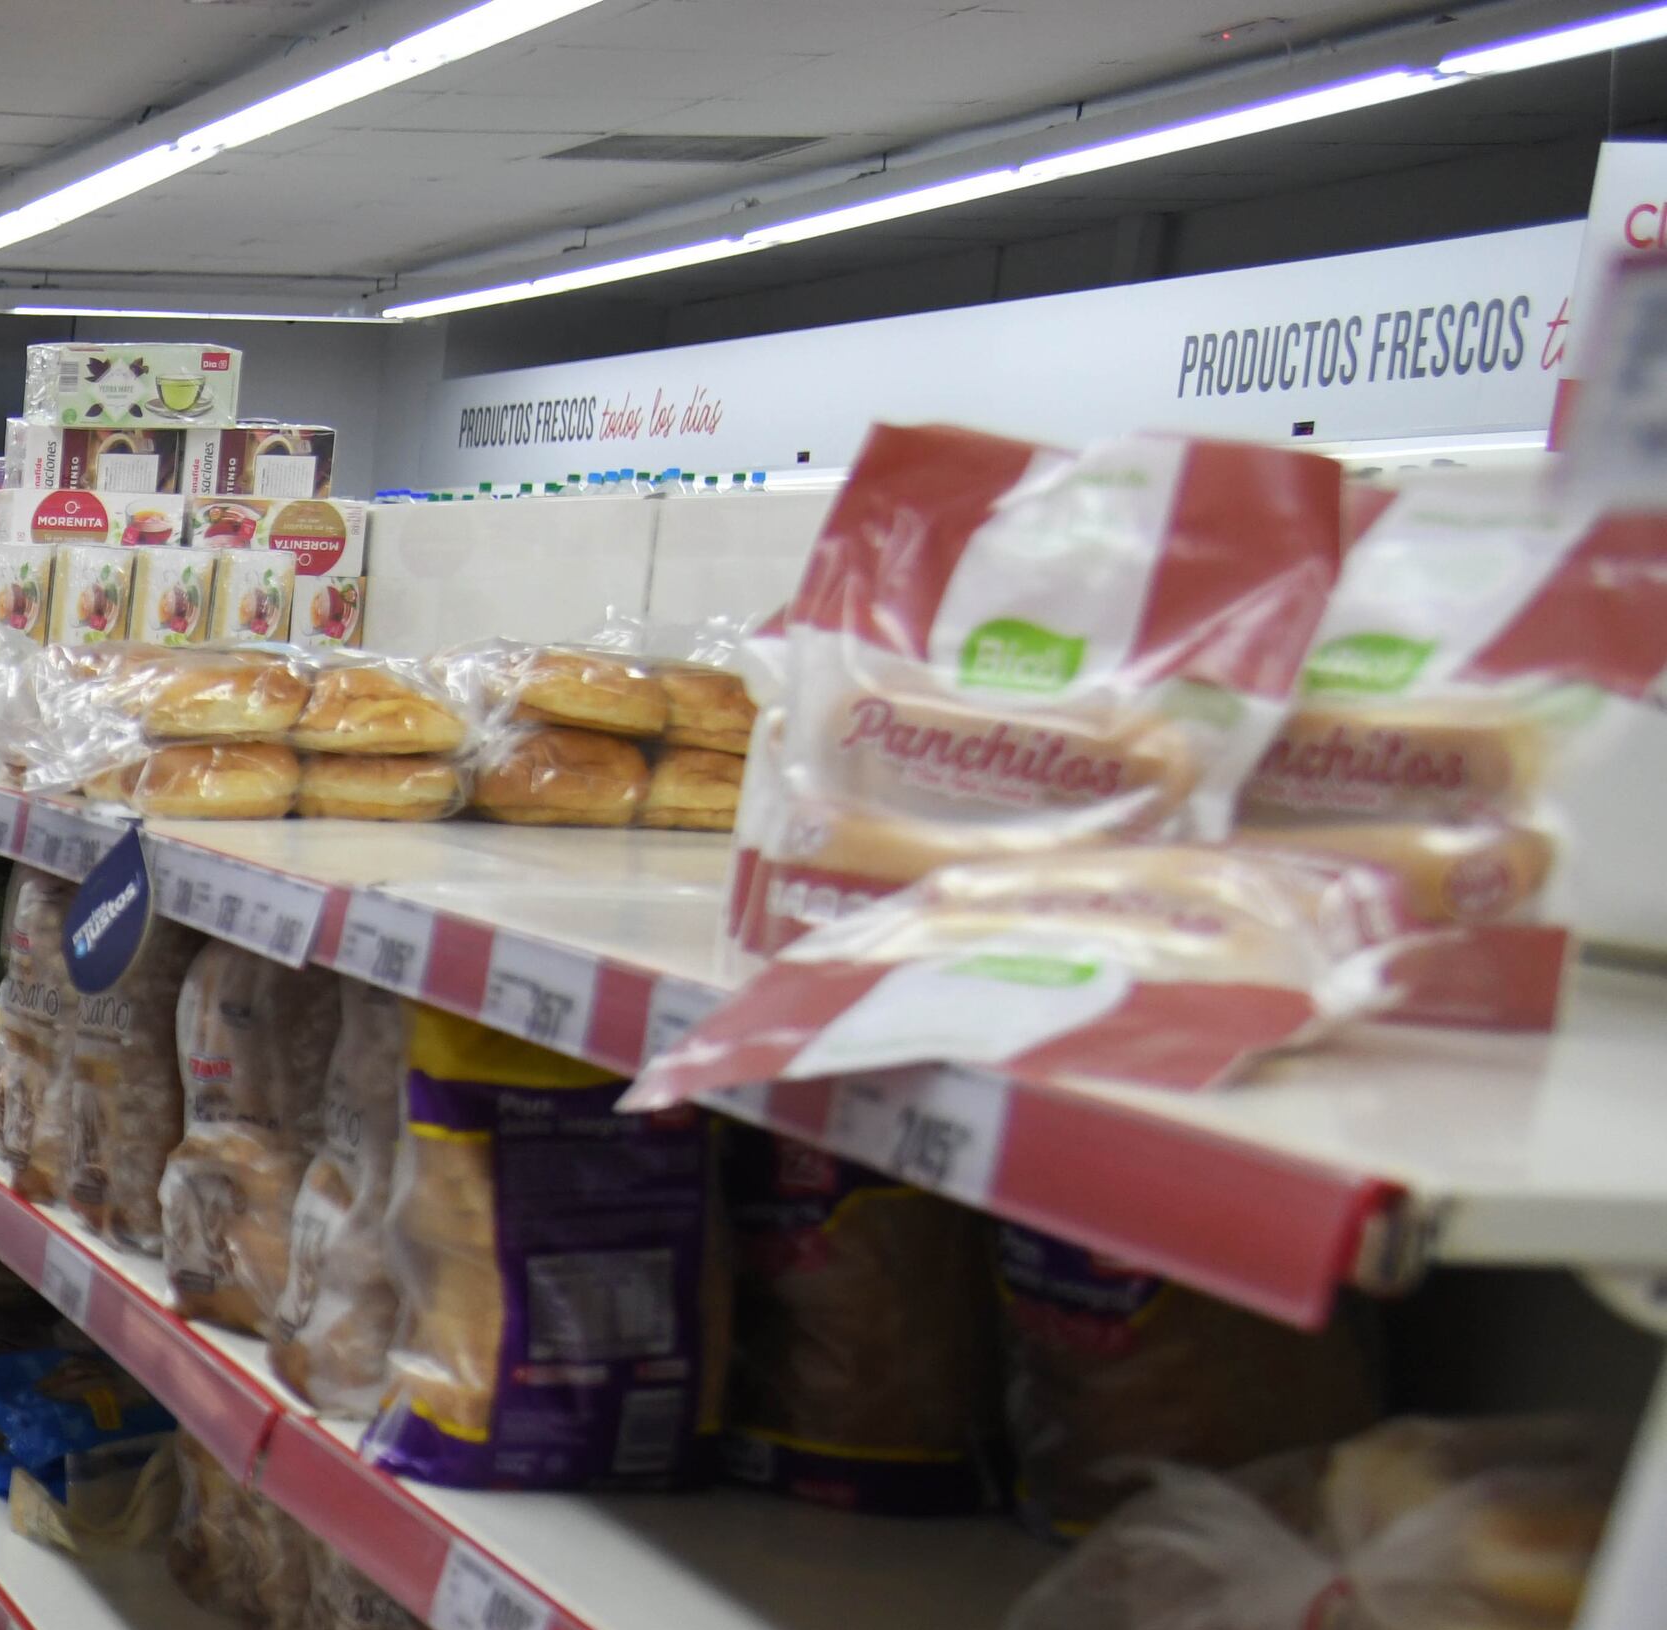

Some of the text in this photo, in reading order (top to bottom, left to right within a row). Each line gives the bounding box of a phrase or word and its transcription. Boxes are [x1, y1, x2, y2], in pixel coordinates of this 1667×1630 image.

[1177, 295, 1530, 399] PRODUCTOS FRESCOS
[459, 384, 723, 449] PRODUCTOS FRESCOS todos los días
[34, 457, 43, 490] nafide
[45, 440, 57, 490] aciones
[191, 458, 201, 494] onafide
[202, 441, 215, 495] saciones
[226, 457, 236, 494] TENSO
[37, 514, 103, 528] MORENITA
[276, 537, 340, 552] MORENITA
[841, 698, 1125, 798] Panchitos
[1260, 729, 1465, 791] nchitos
[82, 880, 138, 953] justos
